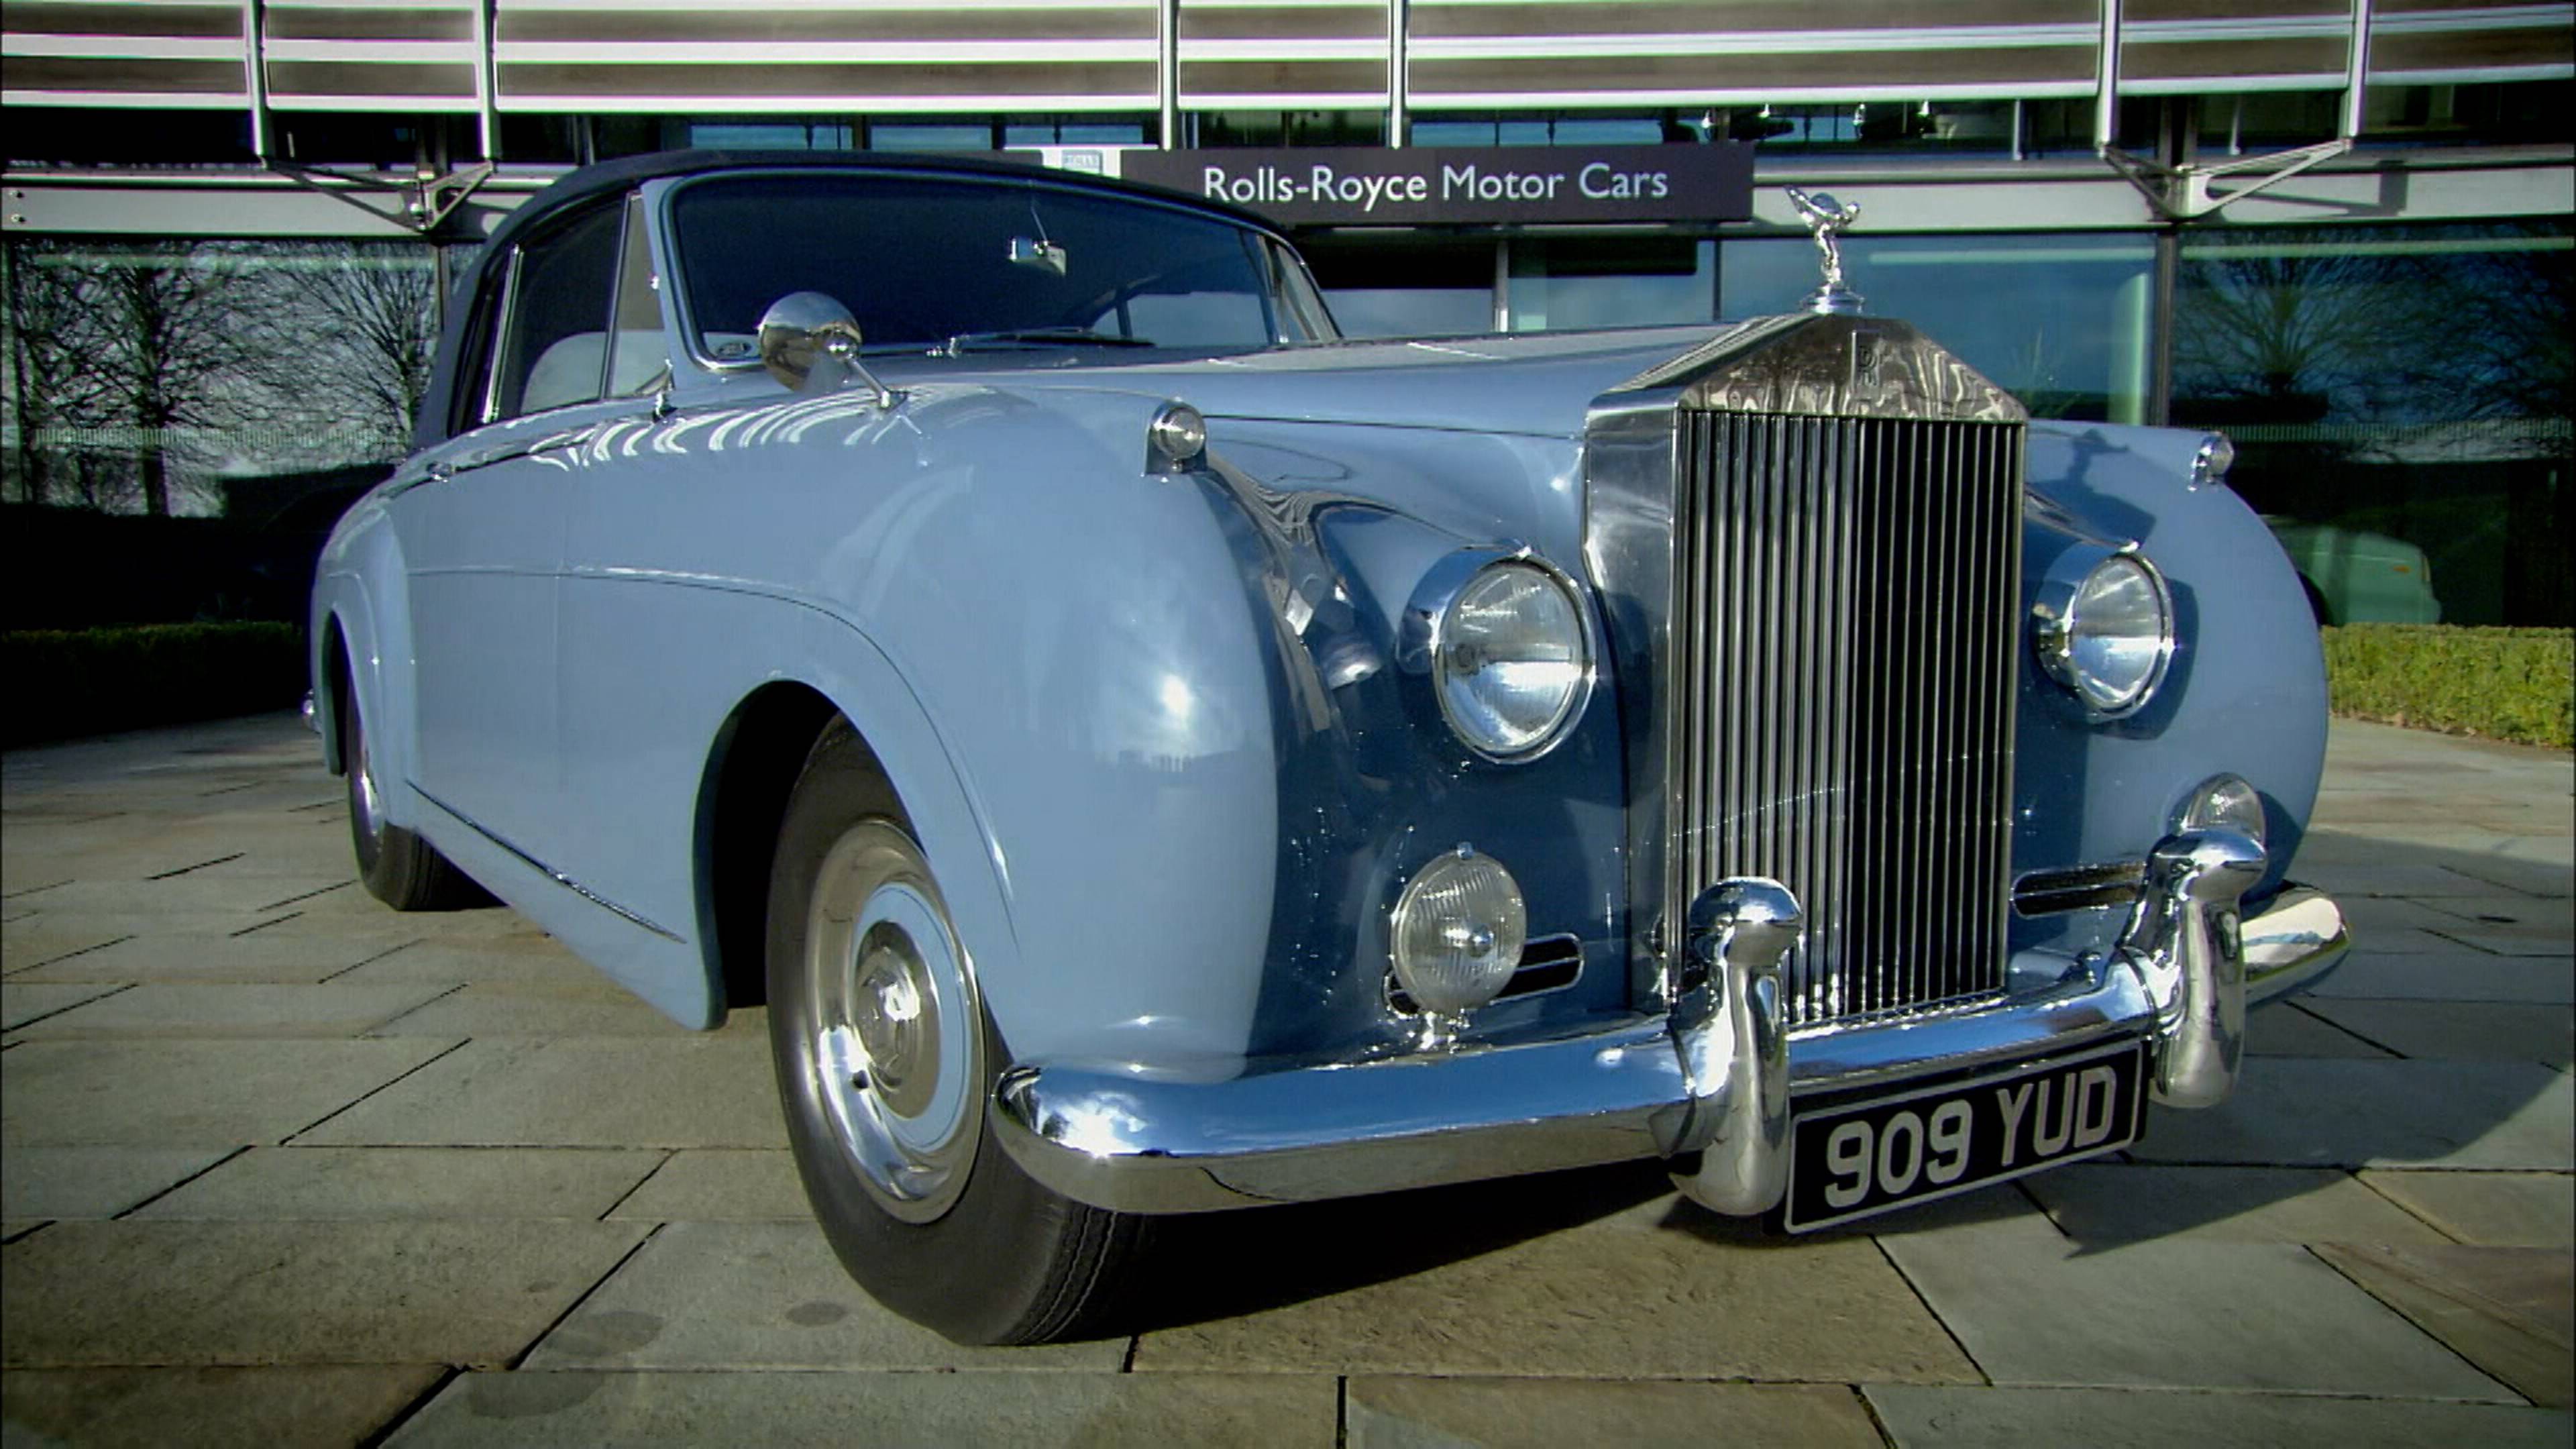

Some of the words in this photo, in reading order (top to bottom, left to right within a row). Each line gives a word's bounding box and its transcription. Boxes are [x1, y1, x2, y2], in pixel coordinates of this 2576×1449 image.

[1204, 166, 1428, 212] Rolls-Royce
[1443, 164, 1565, 201] Motor
[1578, 162, 1668, 199] Cars
[1825, 1098, 1973, 1208] 909
[1996, 1065, 2116, 1166] YUD
